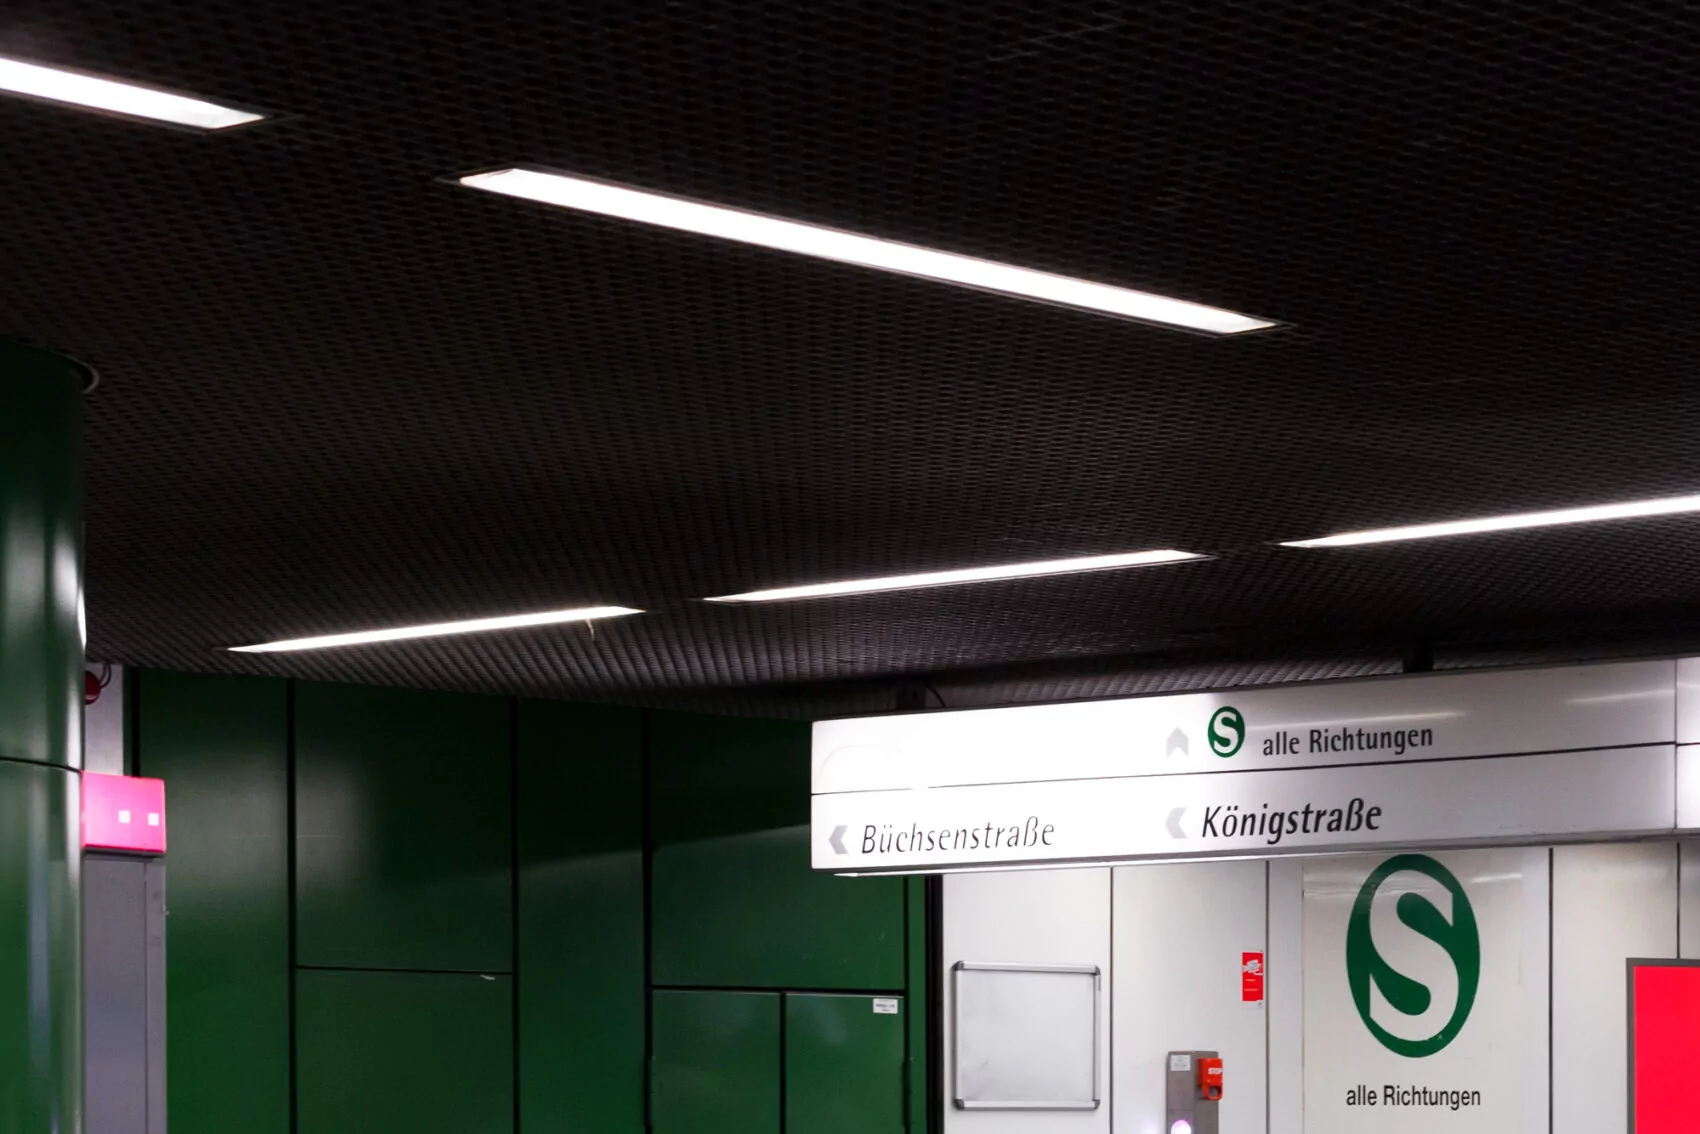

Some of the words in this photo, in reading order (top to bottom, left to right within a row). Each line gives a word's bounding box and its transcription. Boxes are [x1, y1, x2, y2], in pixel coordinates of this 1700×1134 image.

[1211, 710, 1240, 752] S
[1262, 730, 1300, 757] alle
[1309, 725, 1434, 756] Richtungen
[862, 816, 1055, 855] Büchsenstraße
[1202, 798, 1382, 845] Königstraße
[1369, 868, 1460, 1043] S
[1346, 1085, 1378, 1107] alle
[1384, 1085, 1482, 1111] Richtungen
